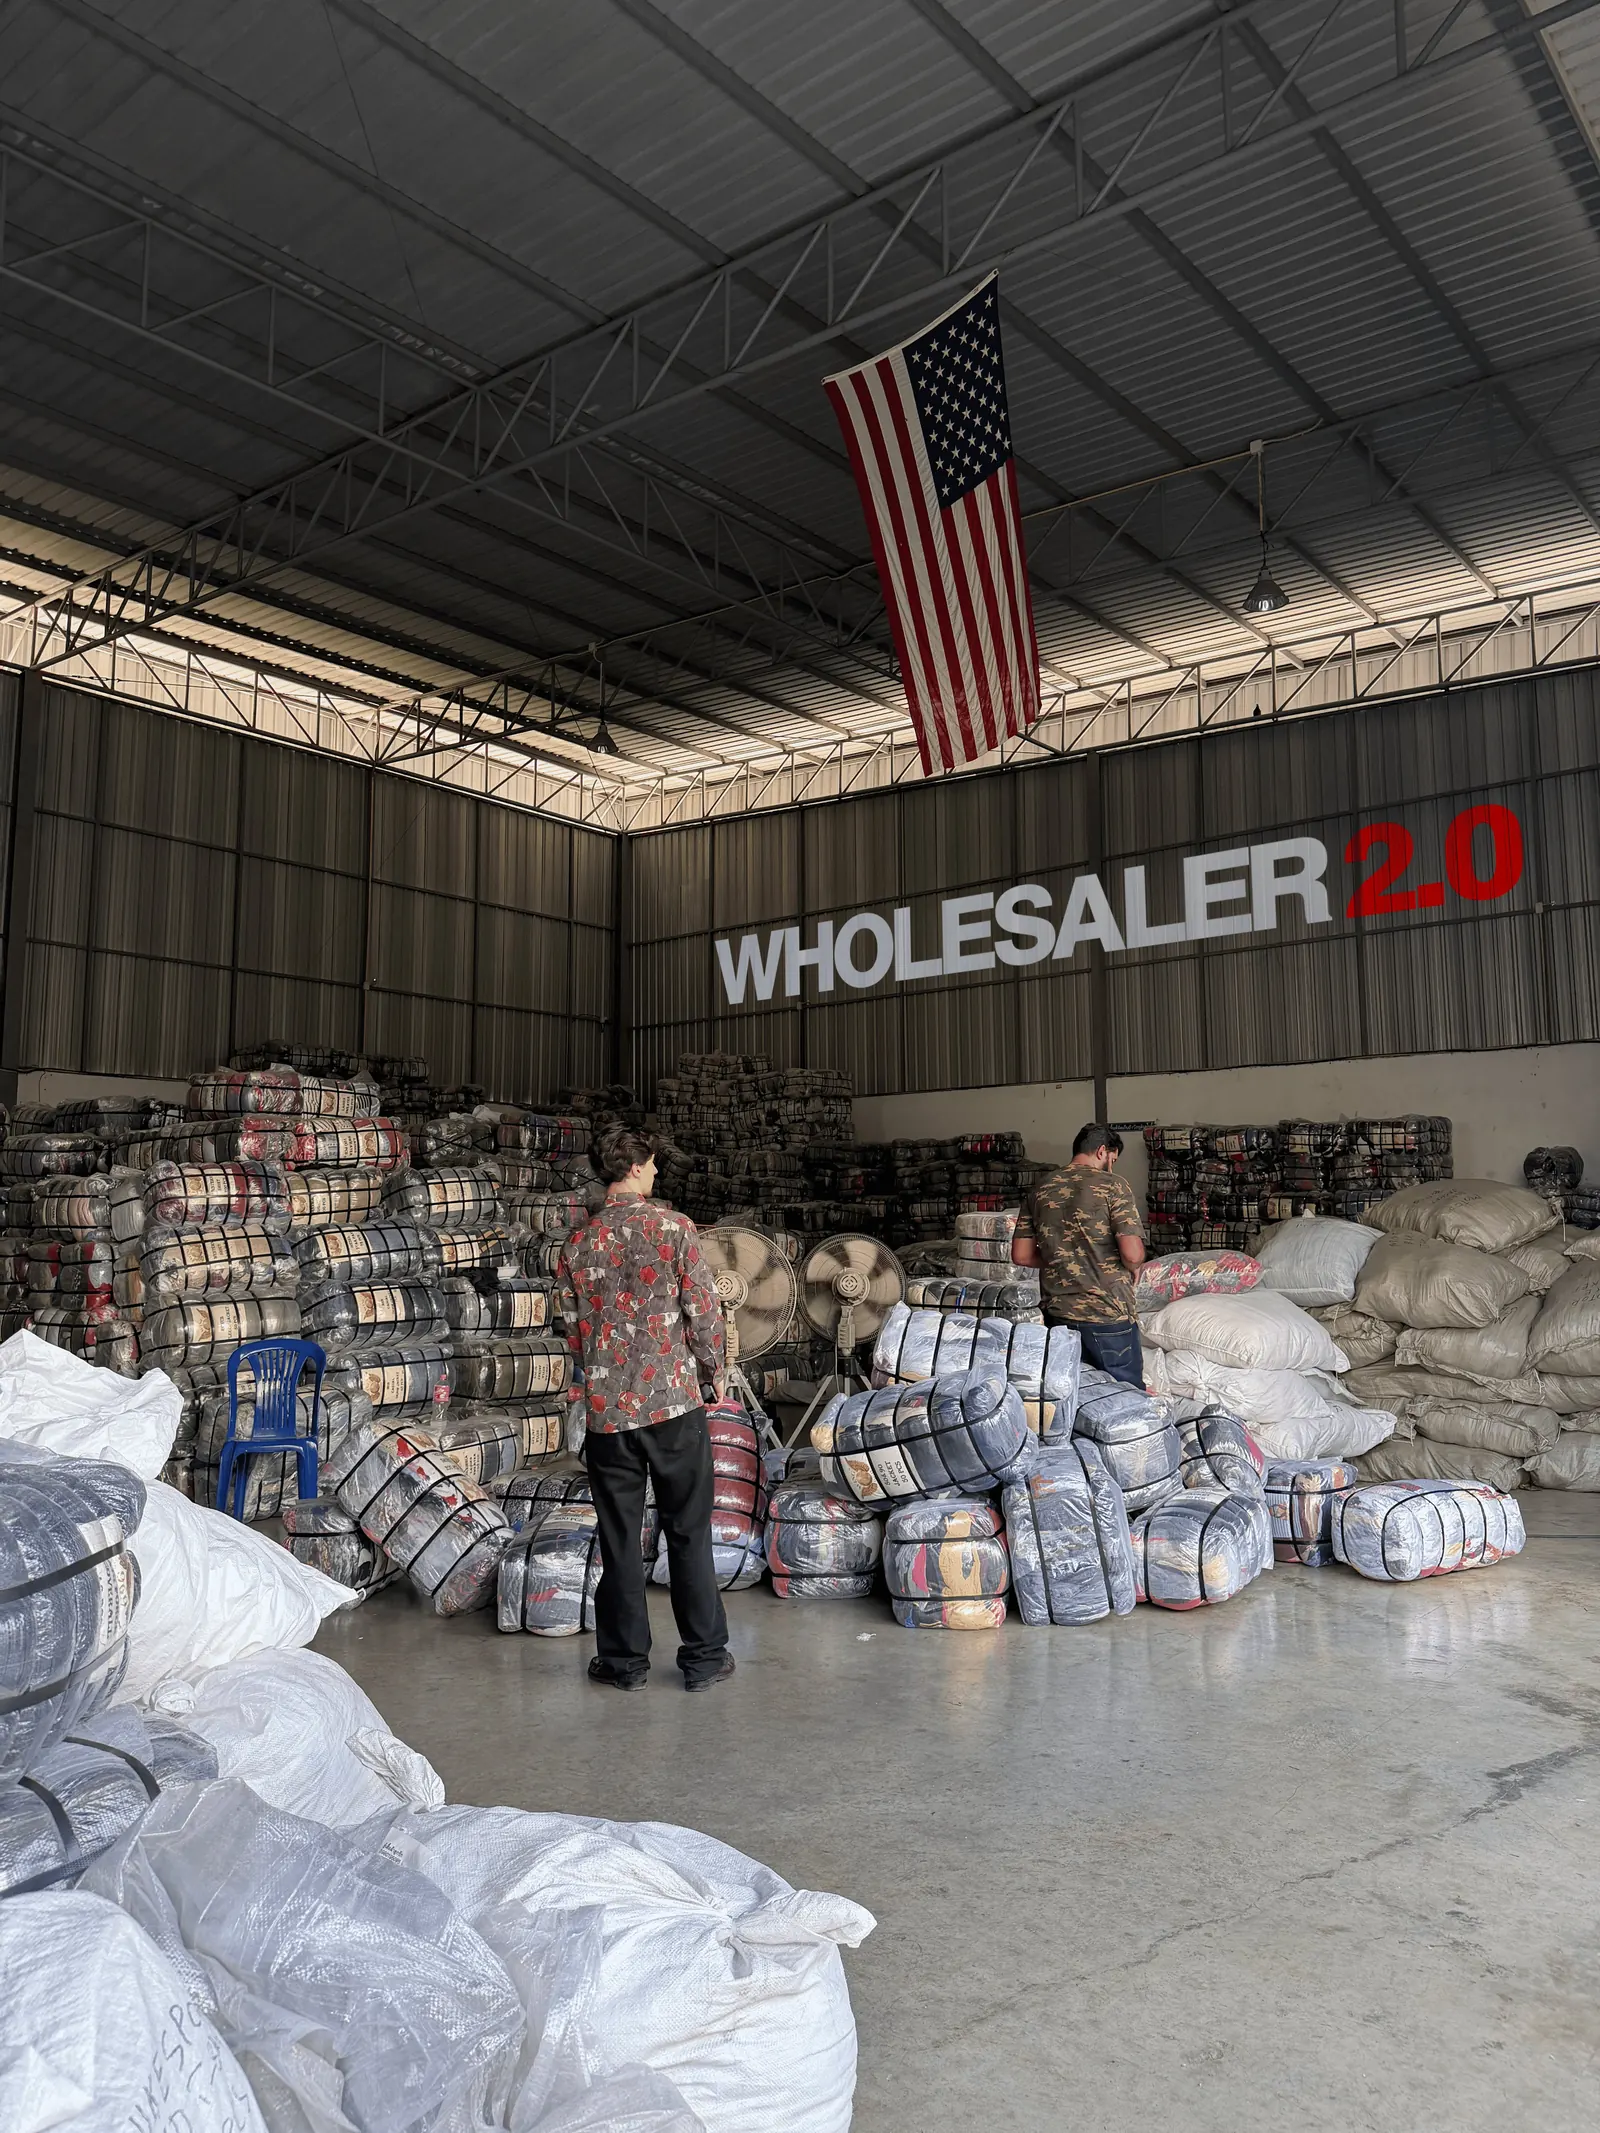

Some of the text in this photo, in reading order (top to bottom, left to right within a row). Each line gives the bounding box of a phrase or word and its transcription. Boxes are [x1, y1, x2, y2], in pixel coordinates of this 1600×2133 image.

[714, 804, 1523, 1005] WHOLESALER 2.0
[884, 1460, 901, 1487] JACKET
[894, 1460, 904, 1474] PCS
